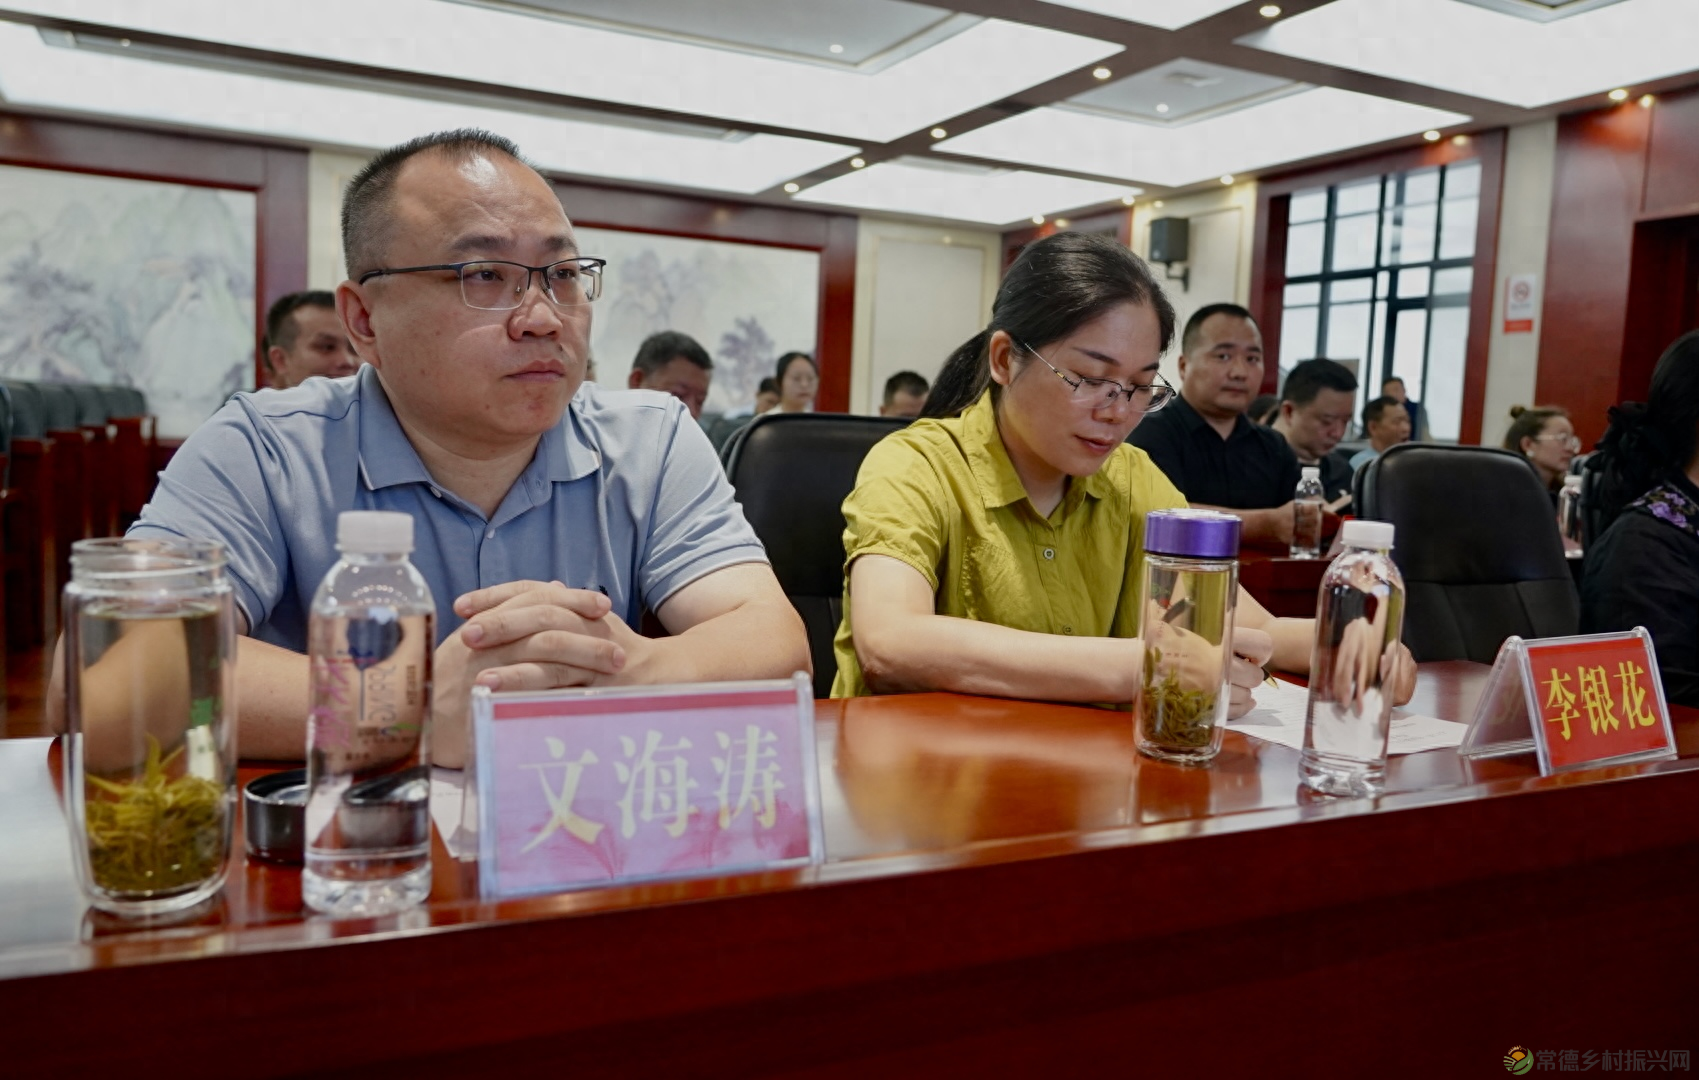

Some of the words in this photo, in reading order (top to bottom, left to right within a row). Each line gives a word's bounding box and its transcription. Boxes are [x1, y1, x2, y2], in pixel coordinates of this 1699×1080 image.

[1541, 661, 1656, 740] 李银花
[518, 725, 784, 854] 文海涛
